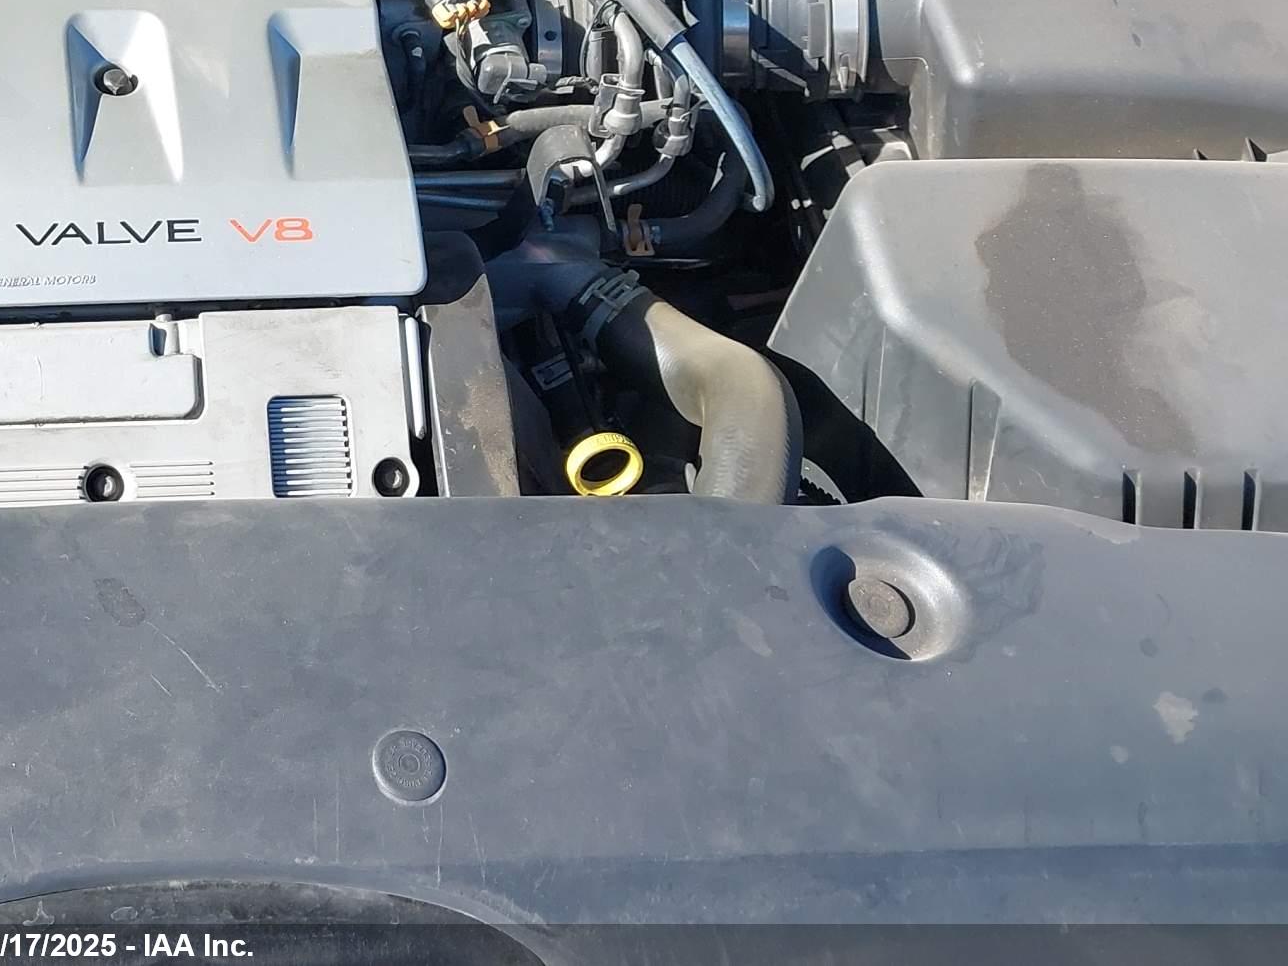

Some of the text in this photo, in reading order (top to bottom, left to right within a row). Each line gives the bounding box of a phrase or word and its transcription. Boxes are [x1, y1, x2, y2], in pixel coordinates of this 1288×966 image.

[15, 219, 203, 247] VALVE
[230, 218, 314, 243] V8
[44, 274, 97, 286] MOTORS
